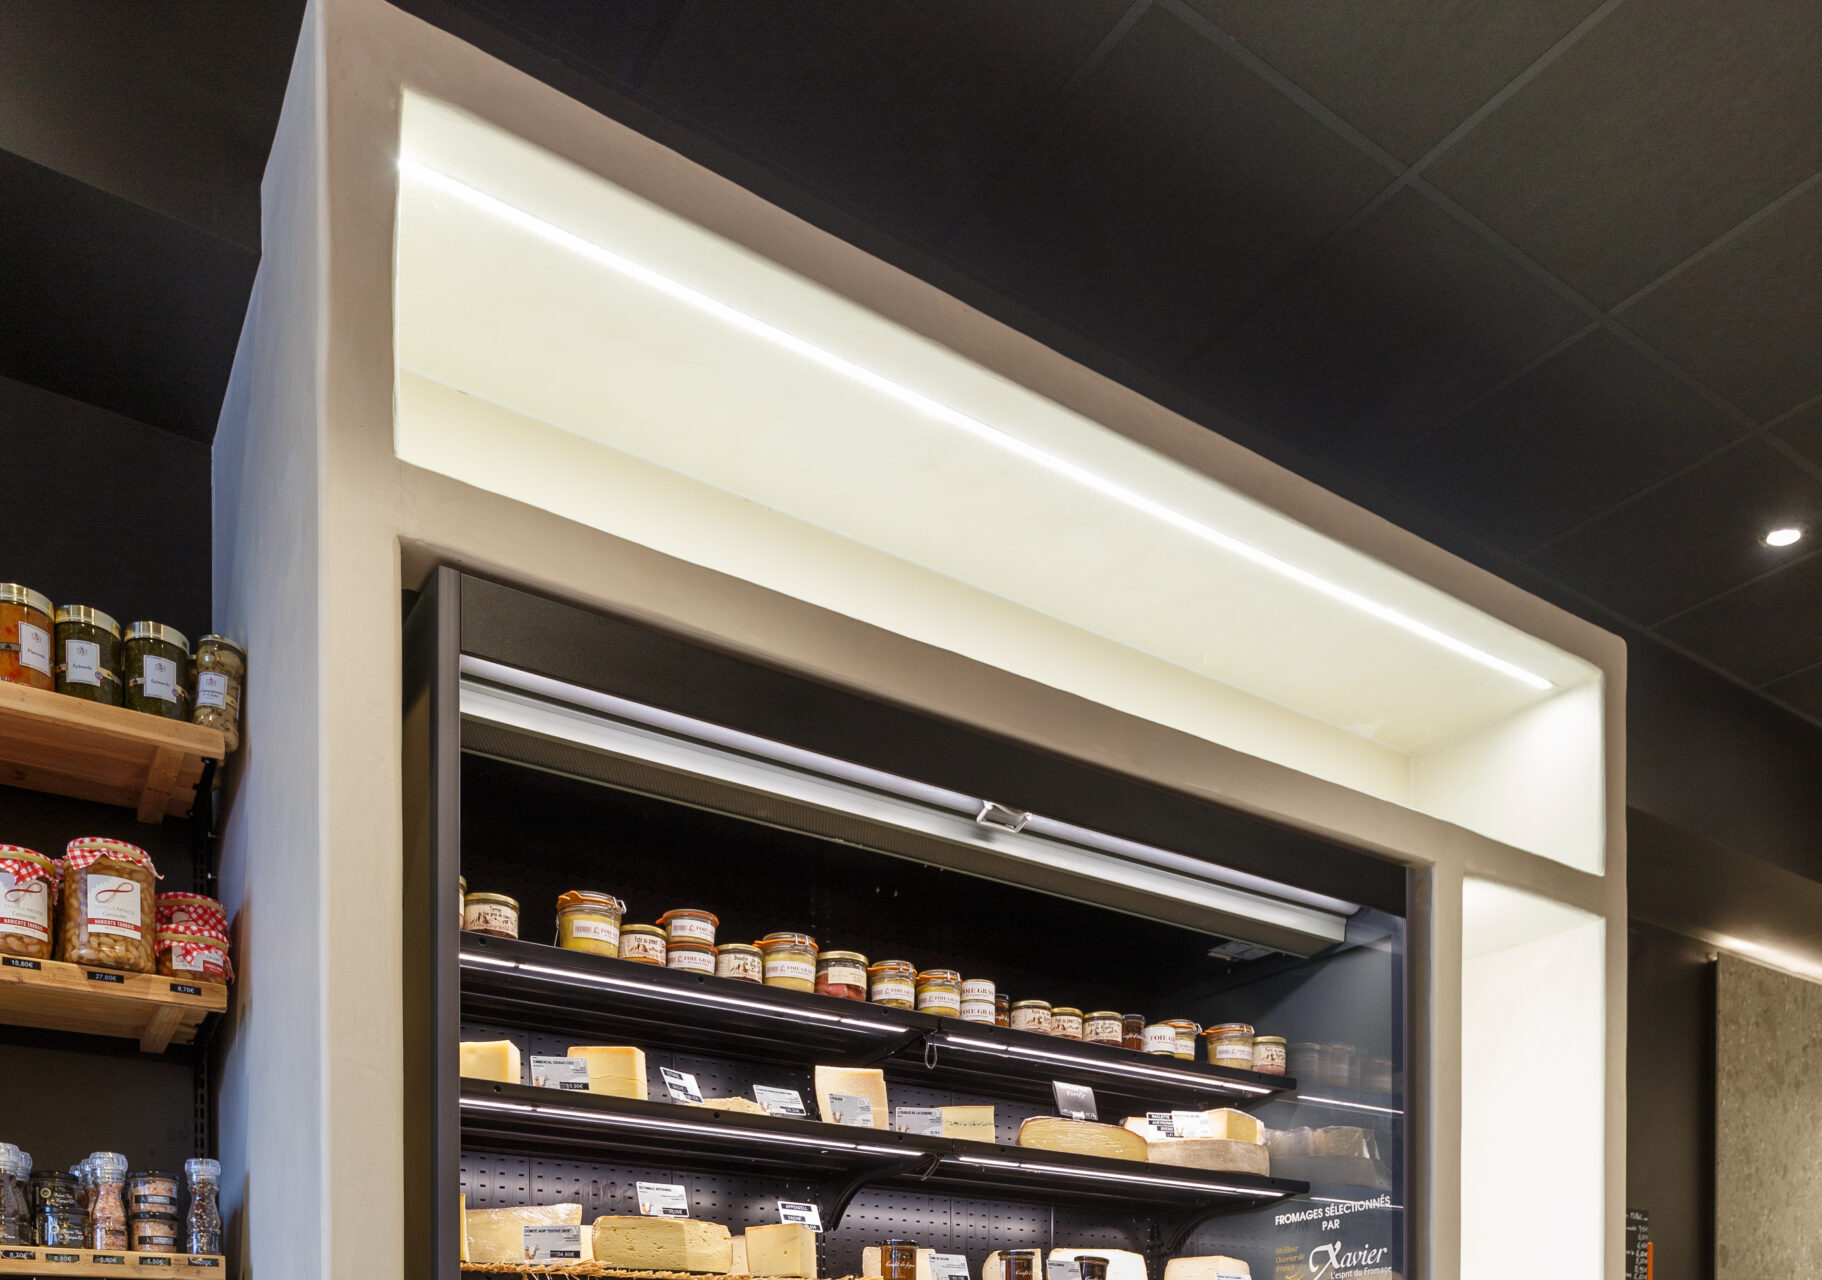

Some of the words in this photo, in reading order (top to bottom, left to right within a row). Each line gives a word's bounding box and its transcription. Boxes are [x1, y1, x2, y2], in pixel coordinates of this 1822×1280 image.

[4, 918, 27, 927] HARICOTS
[94, 919, 116, 927] HARICOTS
[1275, 1208, 1323, 1226] FROMAGES
[1324, 1193, 1391, 1218] SÉLECTIONNÉS
[1322, 1219, 1340, 1231] PAR
[1354, 1268, 1363, 1277] du
[1364, 1266, 1392, 1276] Fromage
